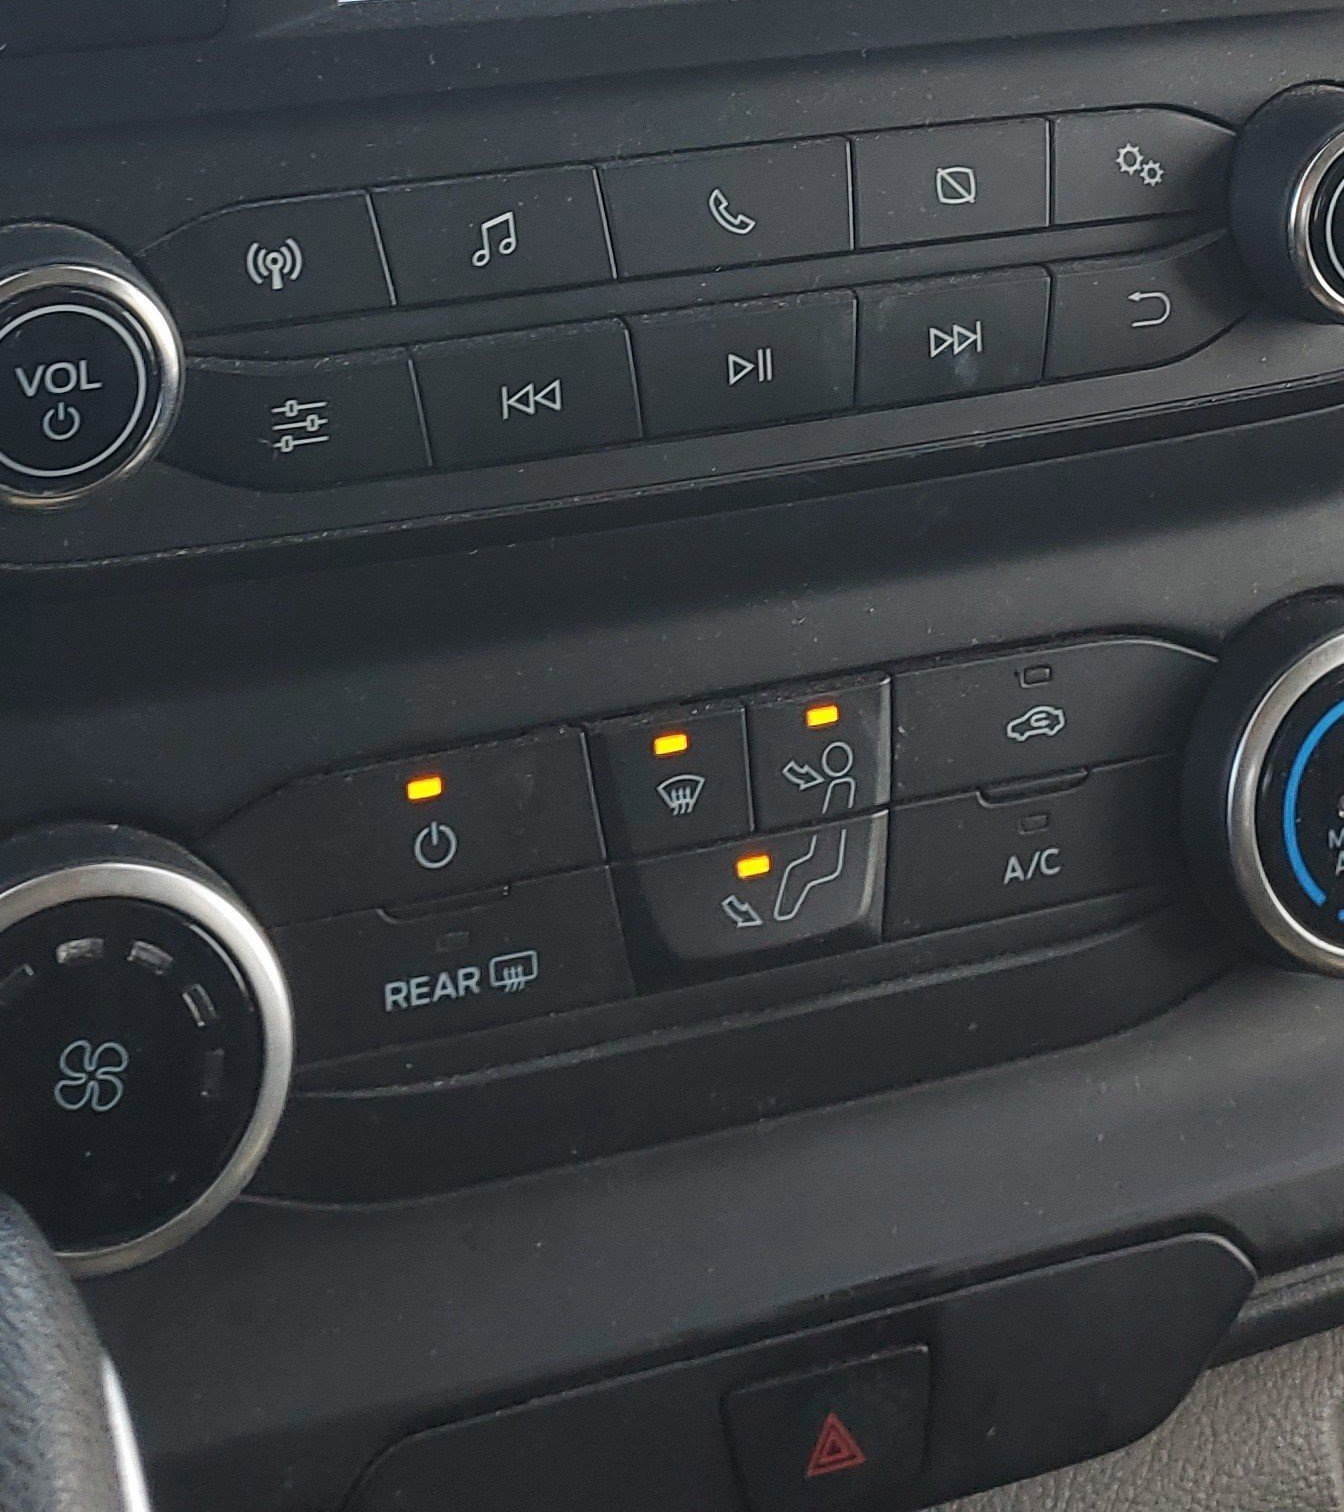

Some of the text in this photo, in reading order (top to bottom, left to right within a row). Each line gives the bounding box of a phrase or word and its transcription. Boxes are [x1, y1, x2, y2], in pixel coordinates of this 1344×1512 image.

[15, 359, 101, 396] VOL
[1003, 848, 1060, 884] A/C
[384, 967, 480, 1011] REAR
